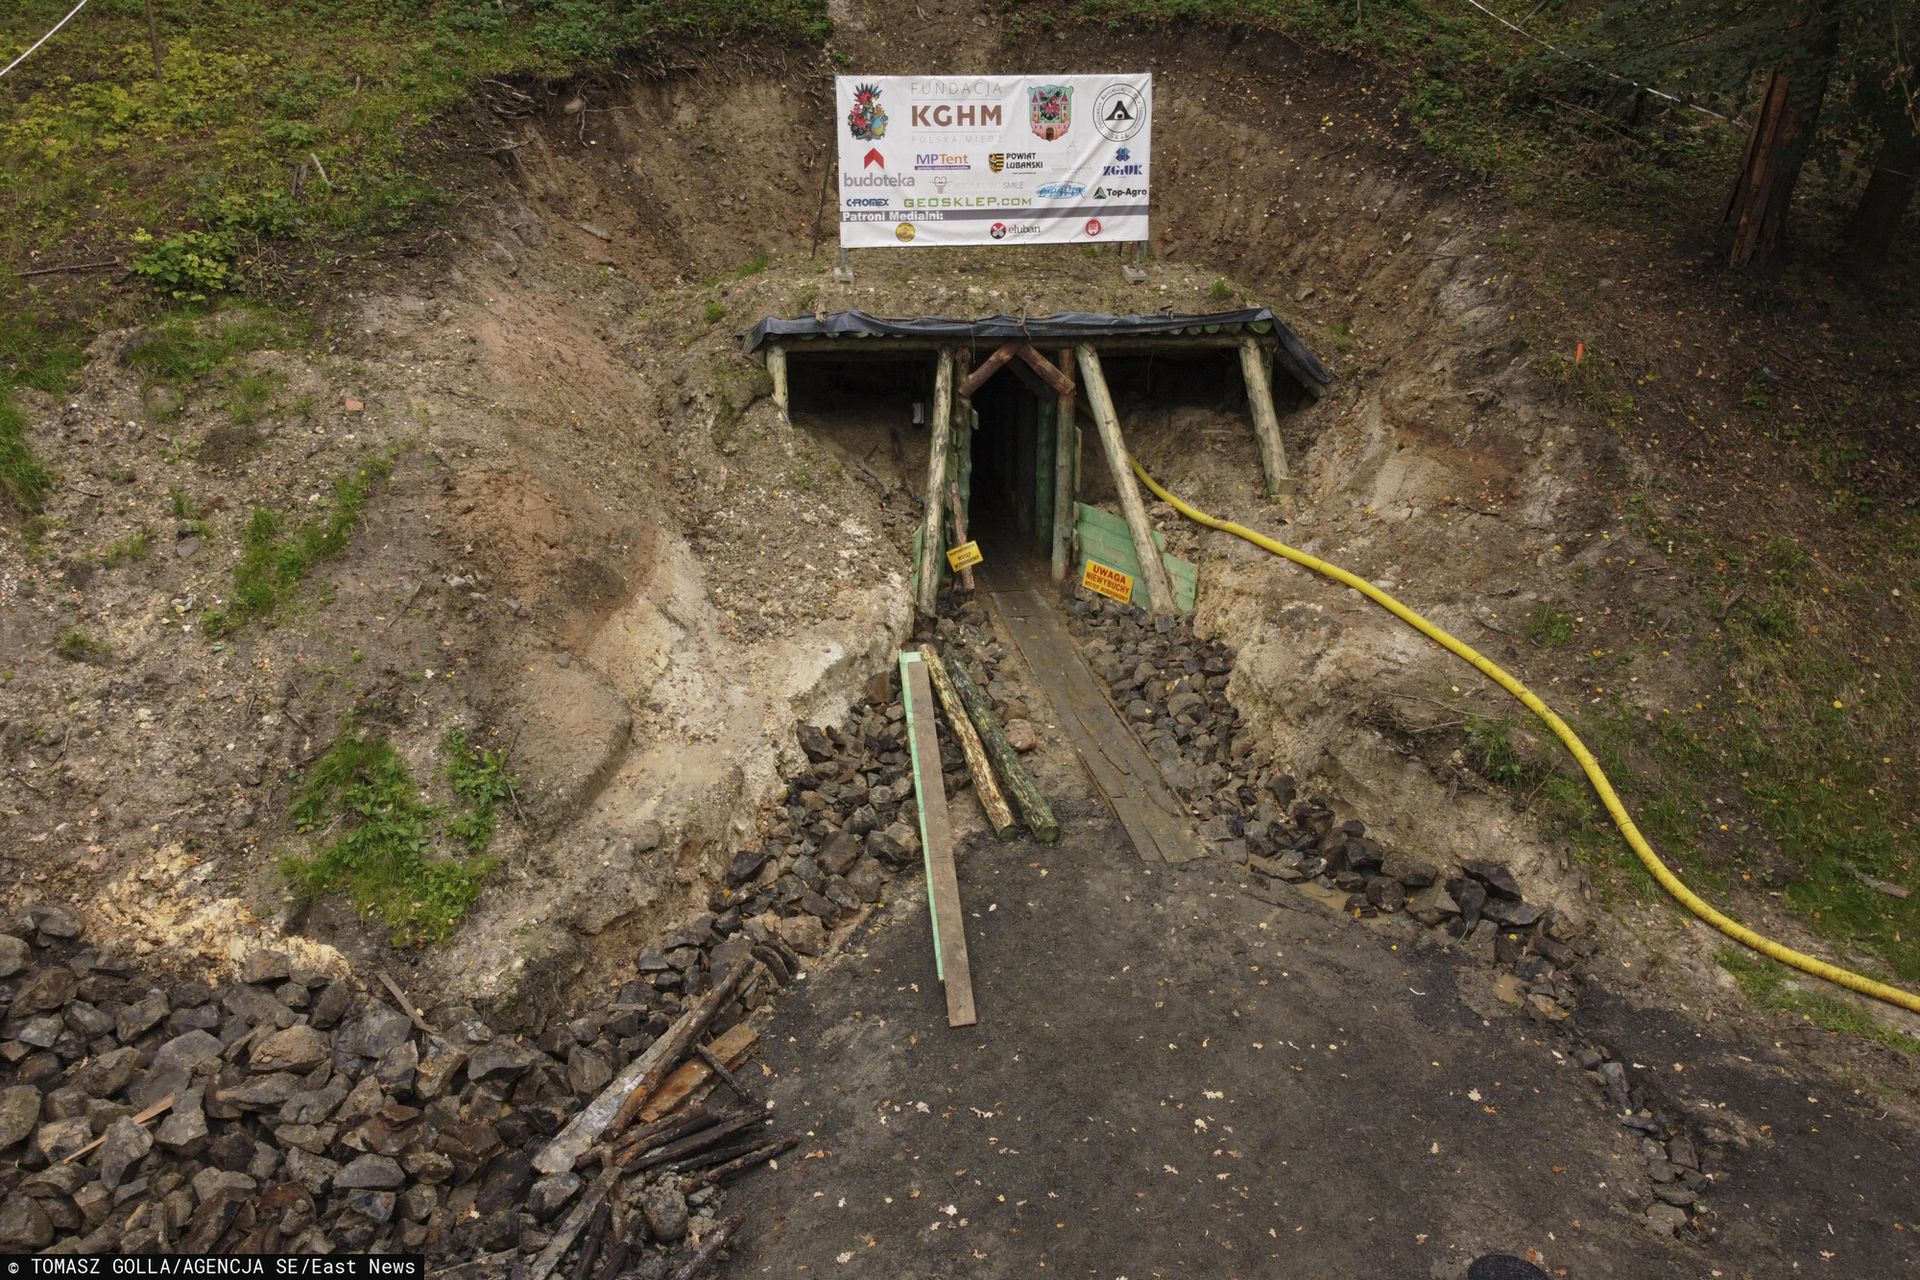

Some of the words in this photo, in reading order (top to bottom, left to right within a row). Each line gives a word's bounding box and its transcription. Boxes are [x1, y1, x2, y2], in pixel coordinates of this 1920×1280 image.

[911, 82, 1002, 97] FUNDACJA
[911, 105, 1002, 127] KGHM
[911, 135, 958, 144] POLSKA
[1006, 152, 1036, 160] POWIAT
[843, 172, 916, 187] budoteka
[1106, 187, 1148, 198] Top-Agro
[842, 211, 886, 221] Patroni
[889, 210, 944, 221] Medialni:
[1093, 564, 1126, 585] UWAGA
[1086, 571, 1130, 595] NIEWYBUCHY
